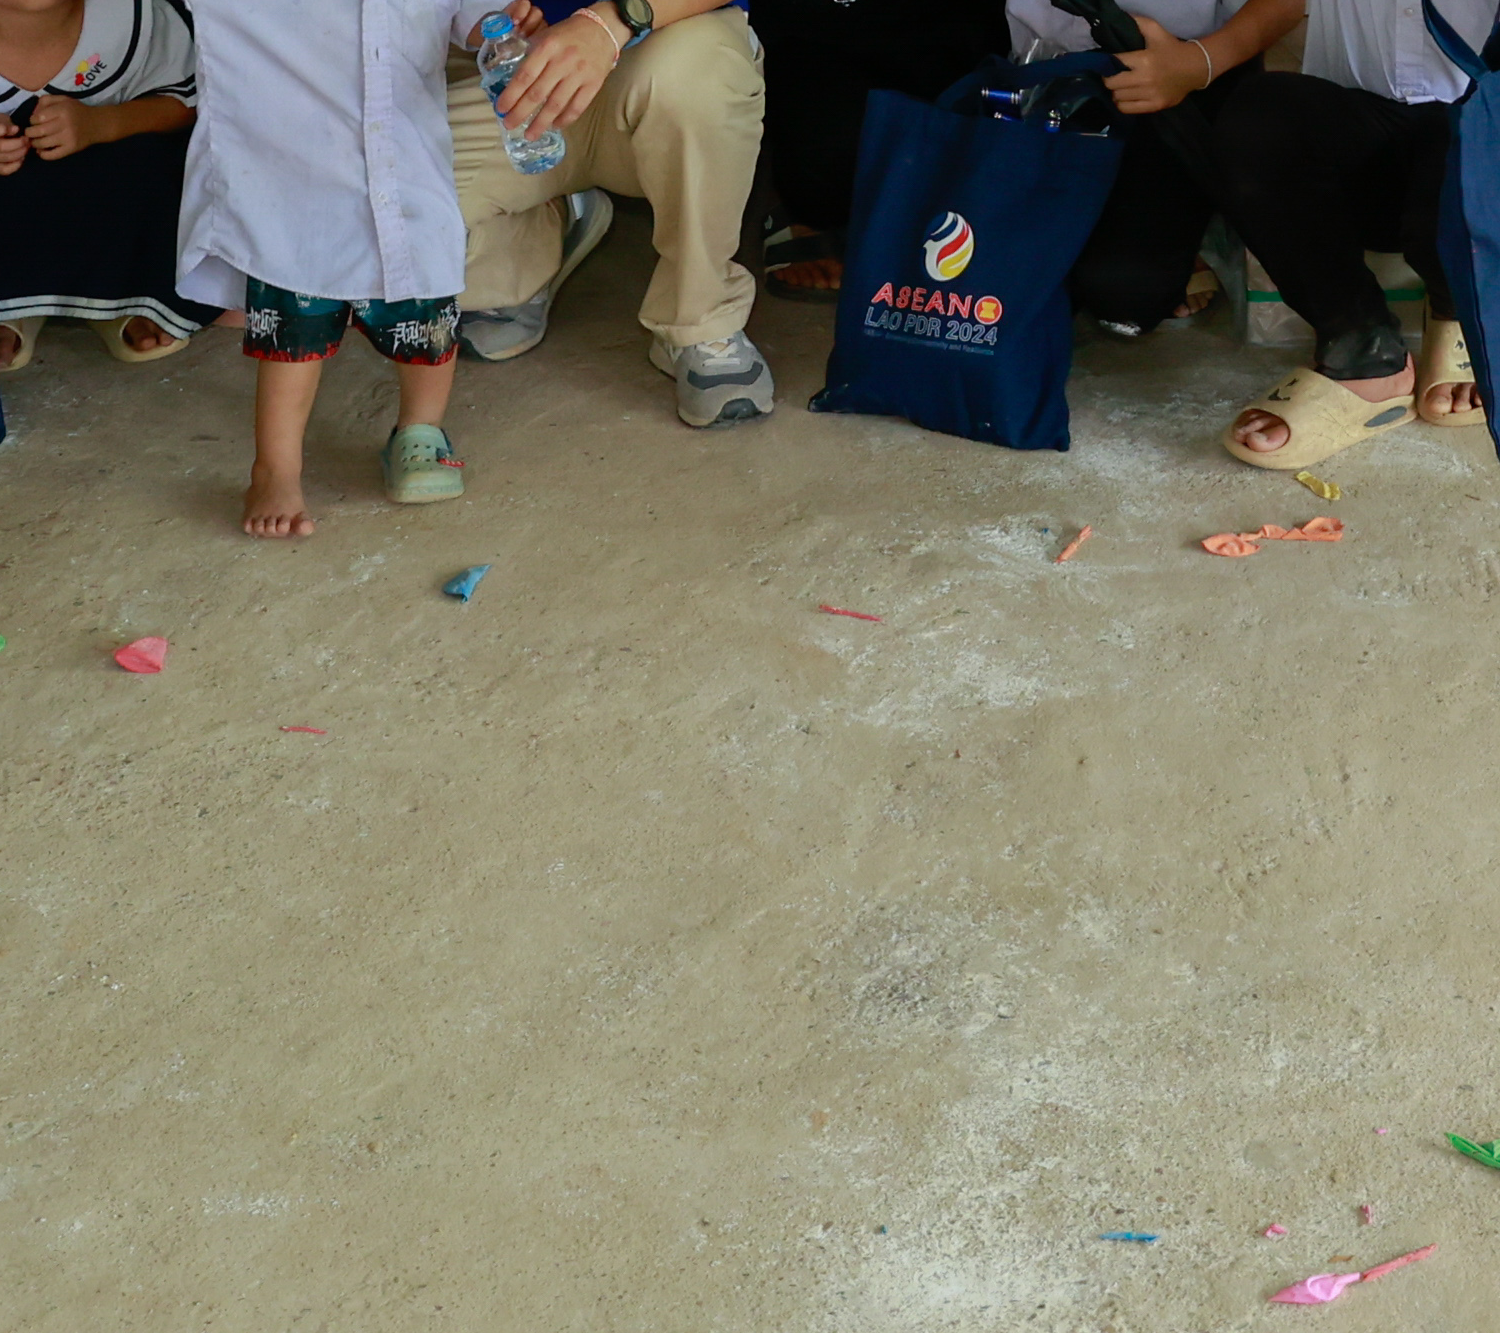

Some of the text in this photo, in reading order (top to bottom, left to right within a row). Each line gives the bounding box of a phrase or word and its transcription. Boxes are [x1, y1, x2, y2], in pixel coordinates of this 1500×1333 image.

[81, 60, 107, 88] LOVE
[869, 281, 974, 319] ASEAN
[863, 305, 1000, 347] LAO PDR 2024
